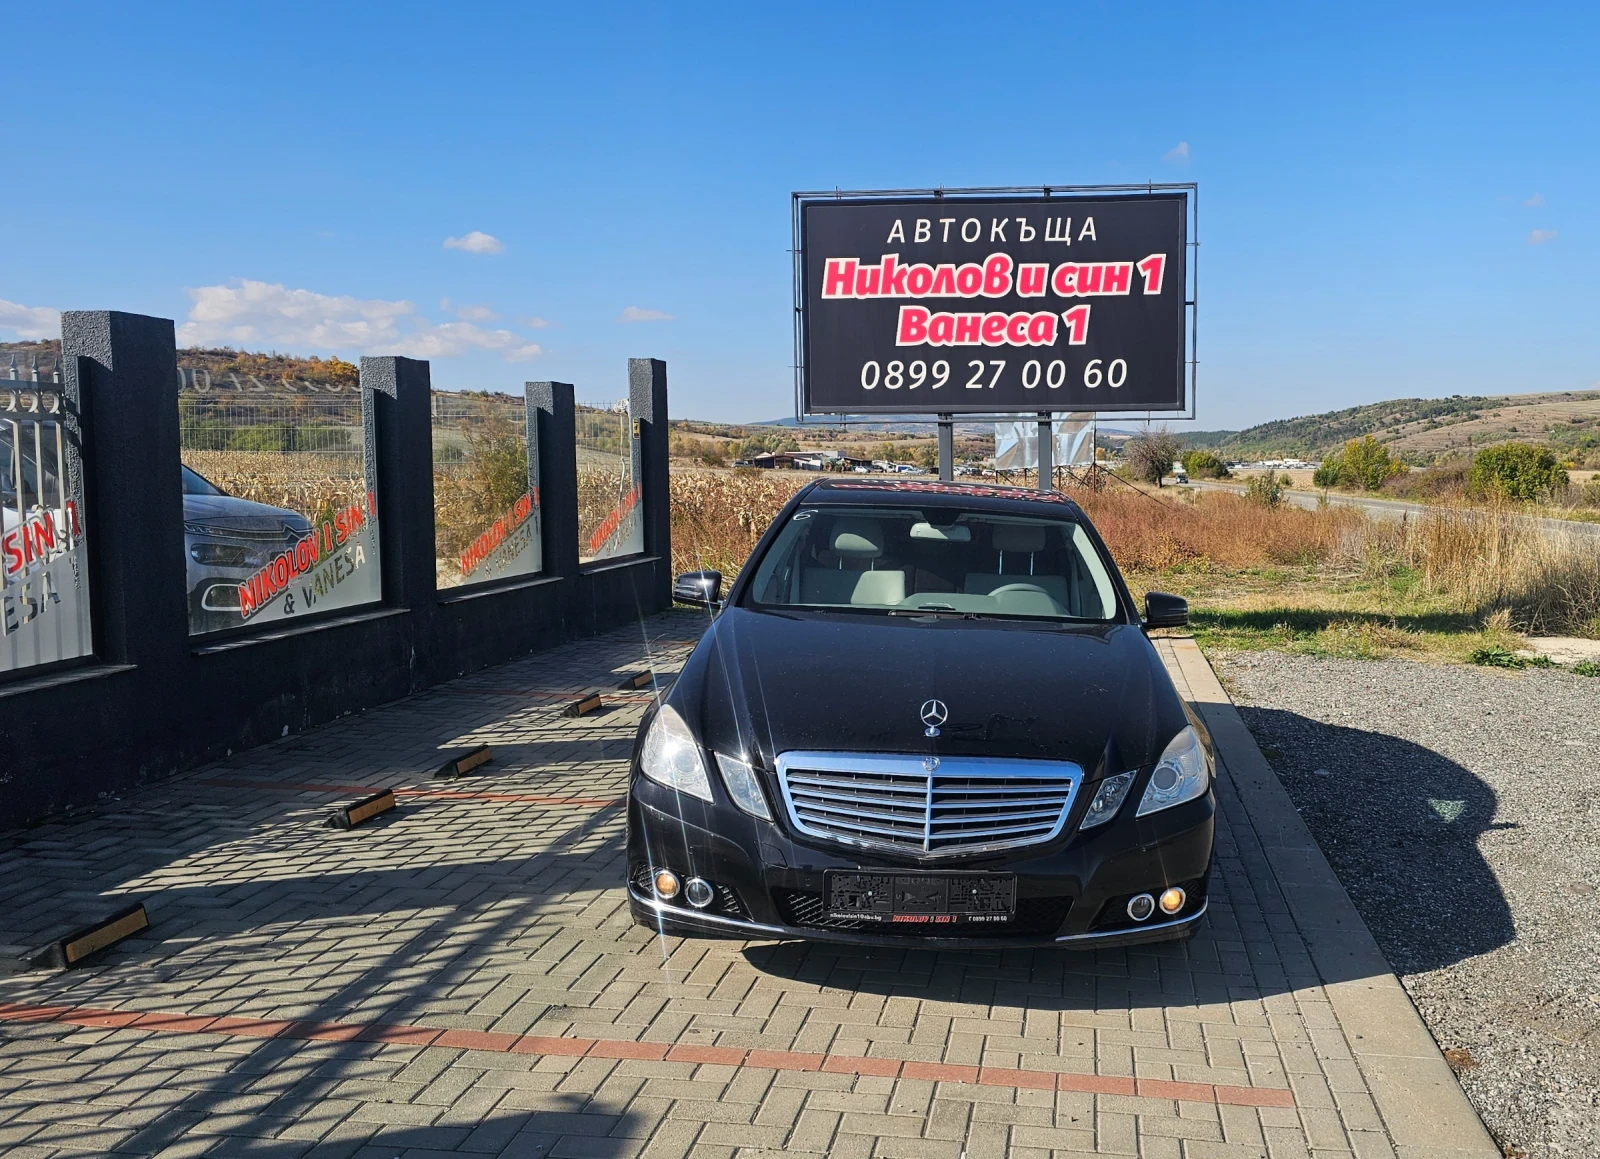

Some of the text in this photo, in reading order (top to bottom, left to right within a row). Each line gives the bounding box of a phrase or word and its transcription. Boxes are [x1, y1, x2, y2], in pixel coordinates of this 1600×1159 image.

[887, 217, 1097, 246] АВТОКЪЩА
[822, 252, 1166, 299] Николов и син 1
[896, 304, 1091, 346] Ванеса 1
[861, 359, 1127, 390] 0899 27 00 60
[1, 509, 58, 577] SIN
[461, 514, 506, 577] NIKOLOV
[514, 493, 532, 527] SIN
[238, 528, 321, 619] NIKOLOV
[323, 521, 334, 553] I
[335, 502, 365, 546] SIN
[283, 593, 295, 615] &
[302, 543, 366, 609] VANESA
[892, 914, 929, 923] NIKOLOV
[935, 915, 951, 923] SIN
